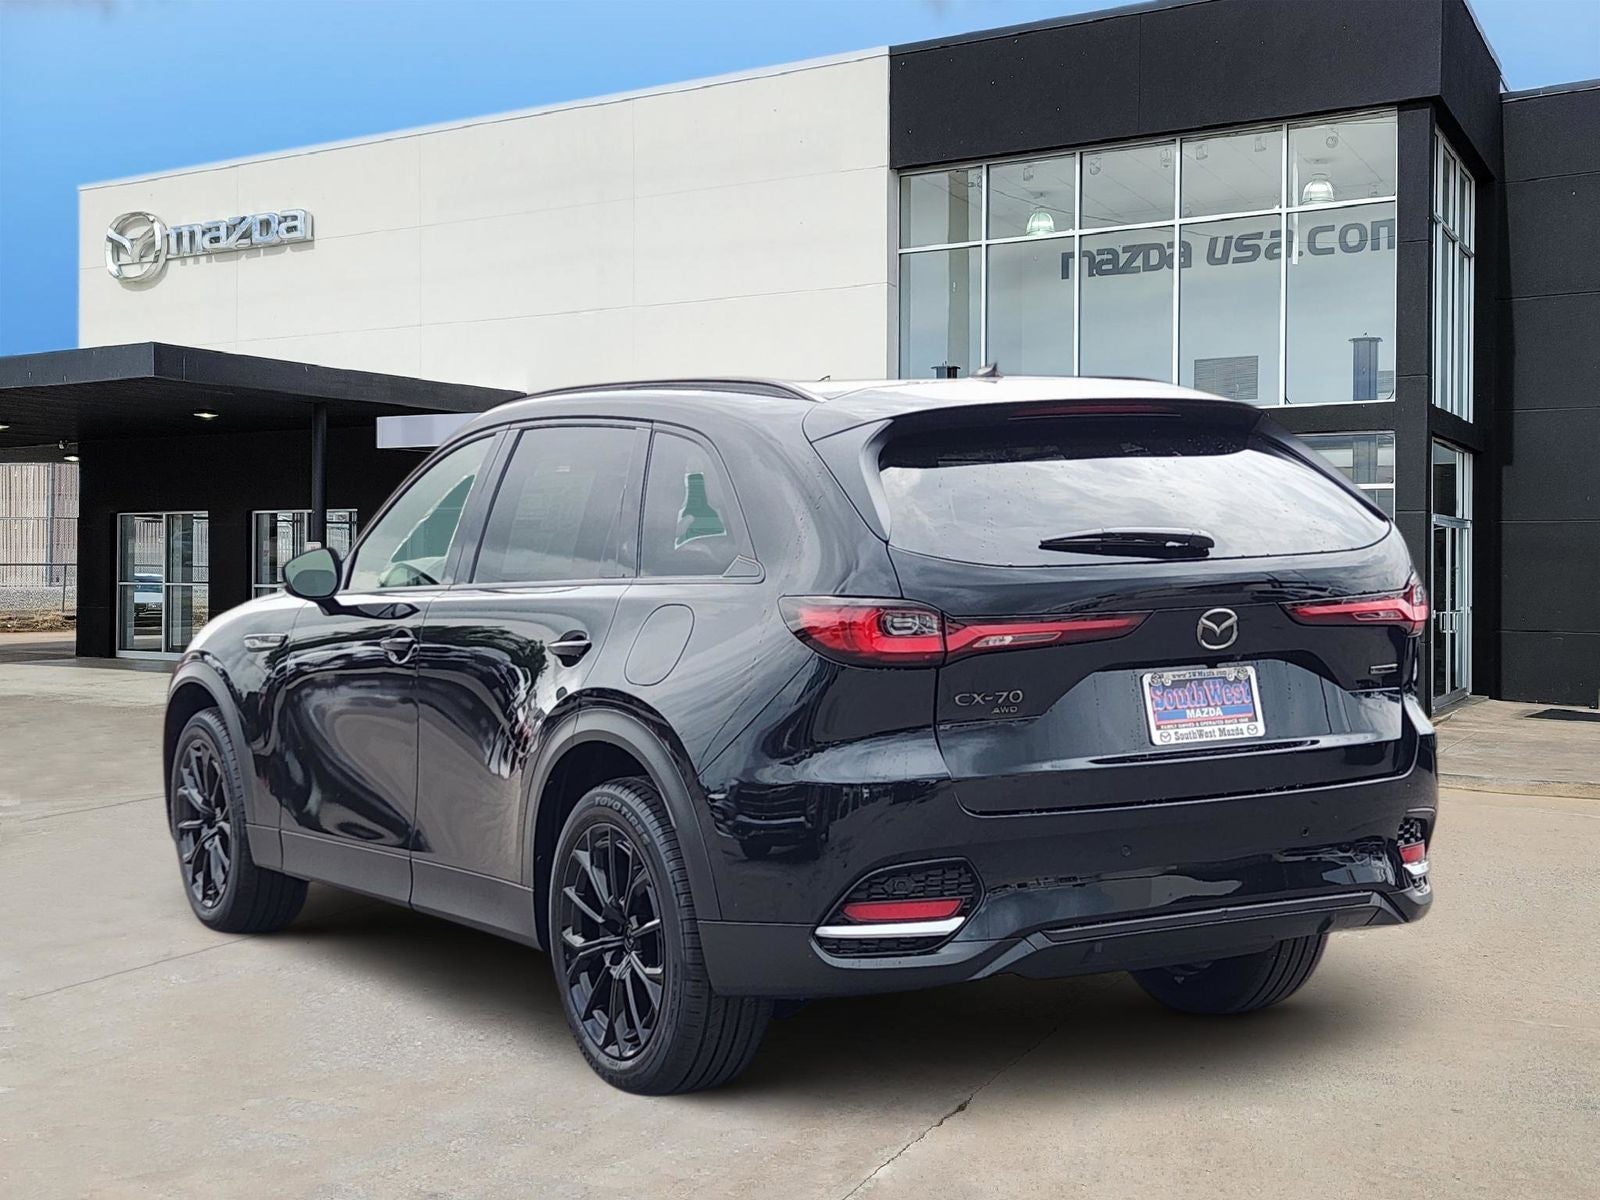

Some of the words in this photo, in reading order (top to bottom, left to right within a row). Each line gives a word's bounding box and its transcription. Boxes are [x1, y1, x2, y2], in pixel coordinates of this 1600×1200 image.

[954, 690, 1023, 706] CX-70
[1151, 679, 1251, 710] SouthWest
[992, 706, 1018, 714] AWD
[1186, 707, 1224, 719] MAZDA
[1174, 729, 1217, 741] SouthWest
[1219, 726, 1245, 737] Mazda
